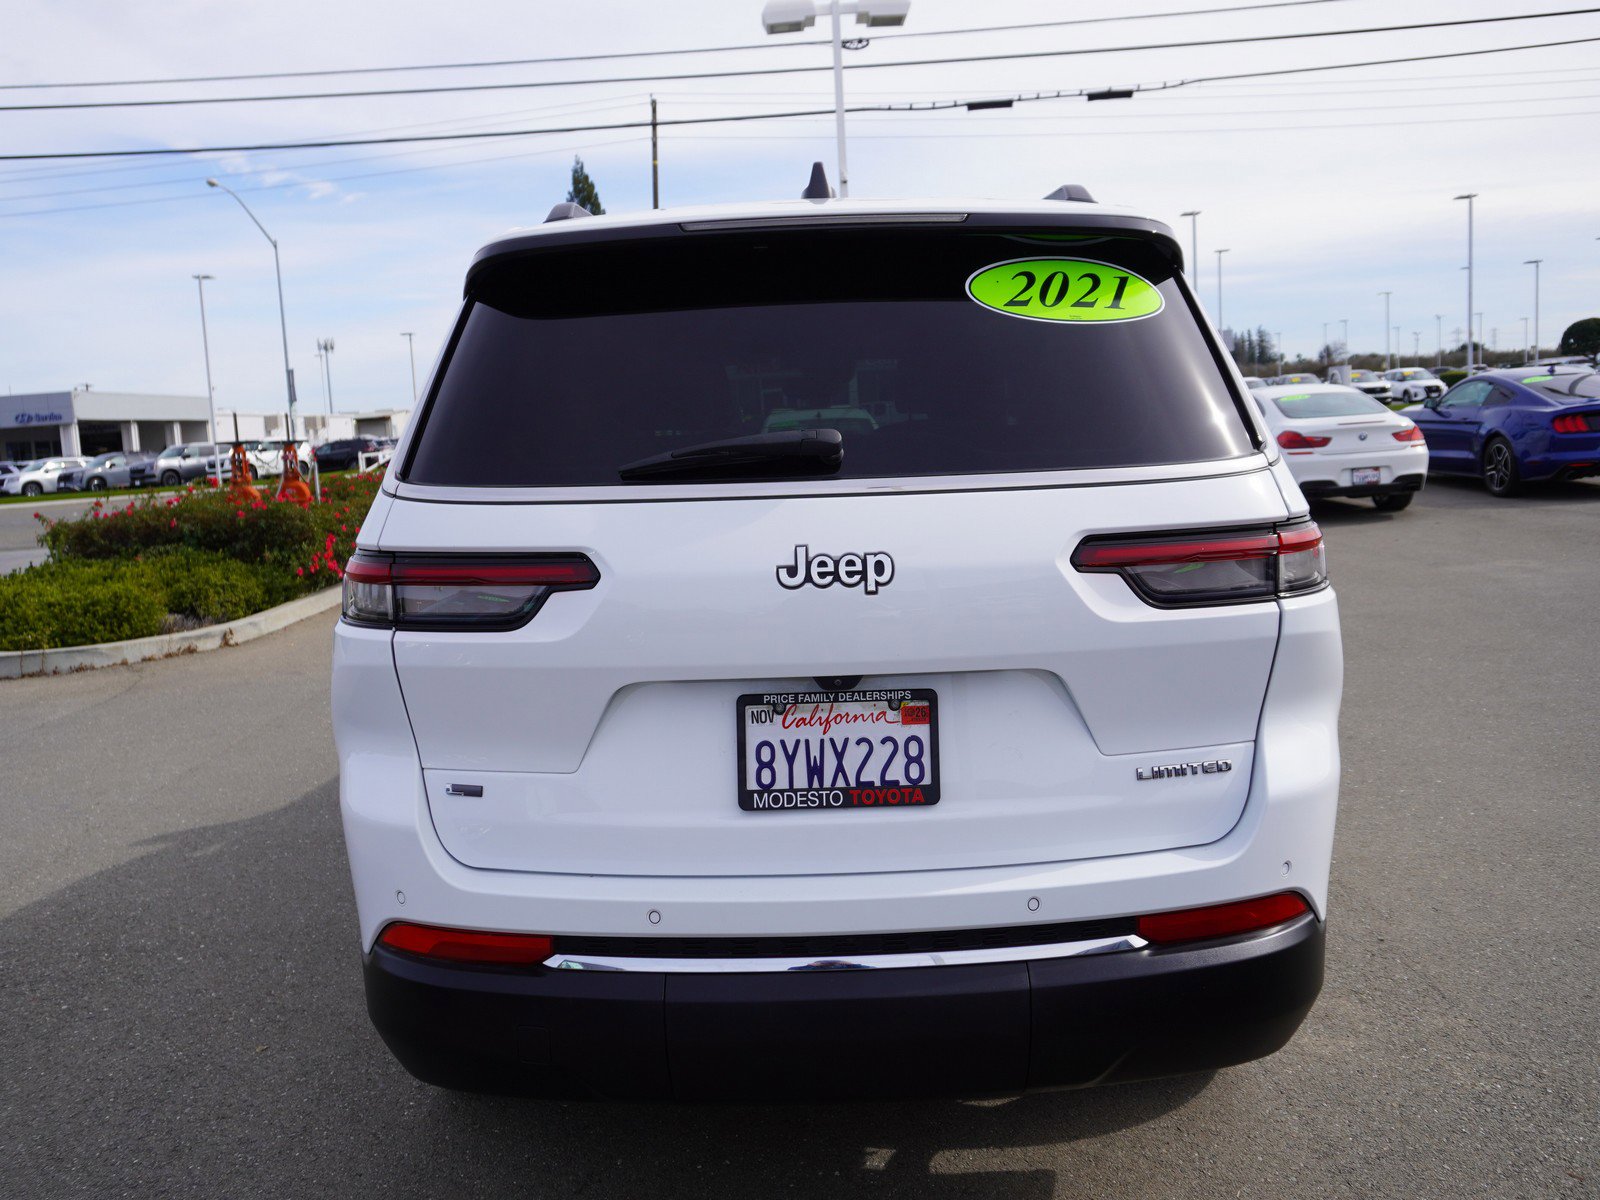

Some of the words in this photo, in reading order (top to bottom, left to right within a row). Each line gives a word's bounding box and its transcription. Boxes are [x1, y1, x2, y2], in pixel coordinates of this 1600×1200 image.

[1003, 271, 1130, 310] 2021
[776, 544, 895, 595] Jeep
[763, 694, 795, 704] PRICE
[798, 693, 835, 703] FAMILY
[838, 690, 912, 701] DEALERSHIPS
[751, 709, 774, 724] NOV
[781, 703, 901, 735] California
[755, 735, 925, 790] 8YWX228
[1136, 759, 1232, 781] LIMITED
[753, 791, 844, 809] MODESTO
[850, 788, 925, 805] TOYOTA
